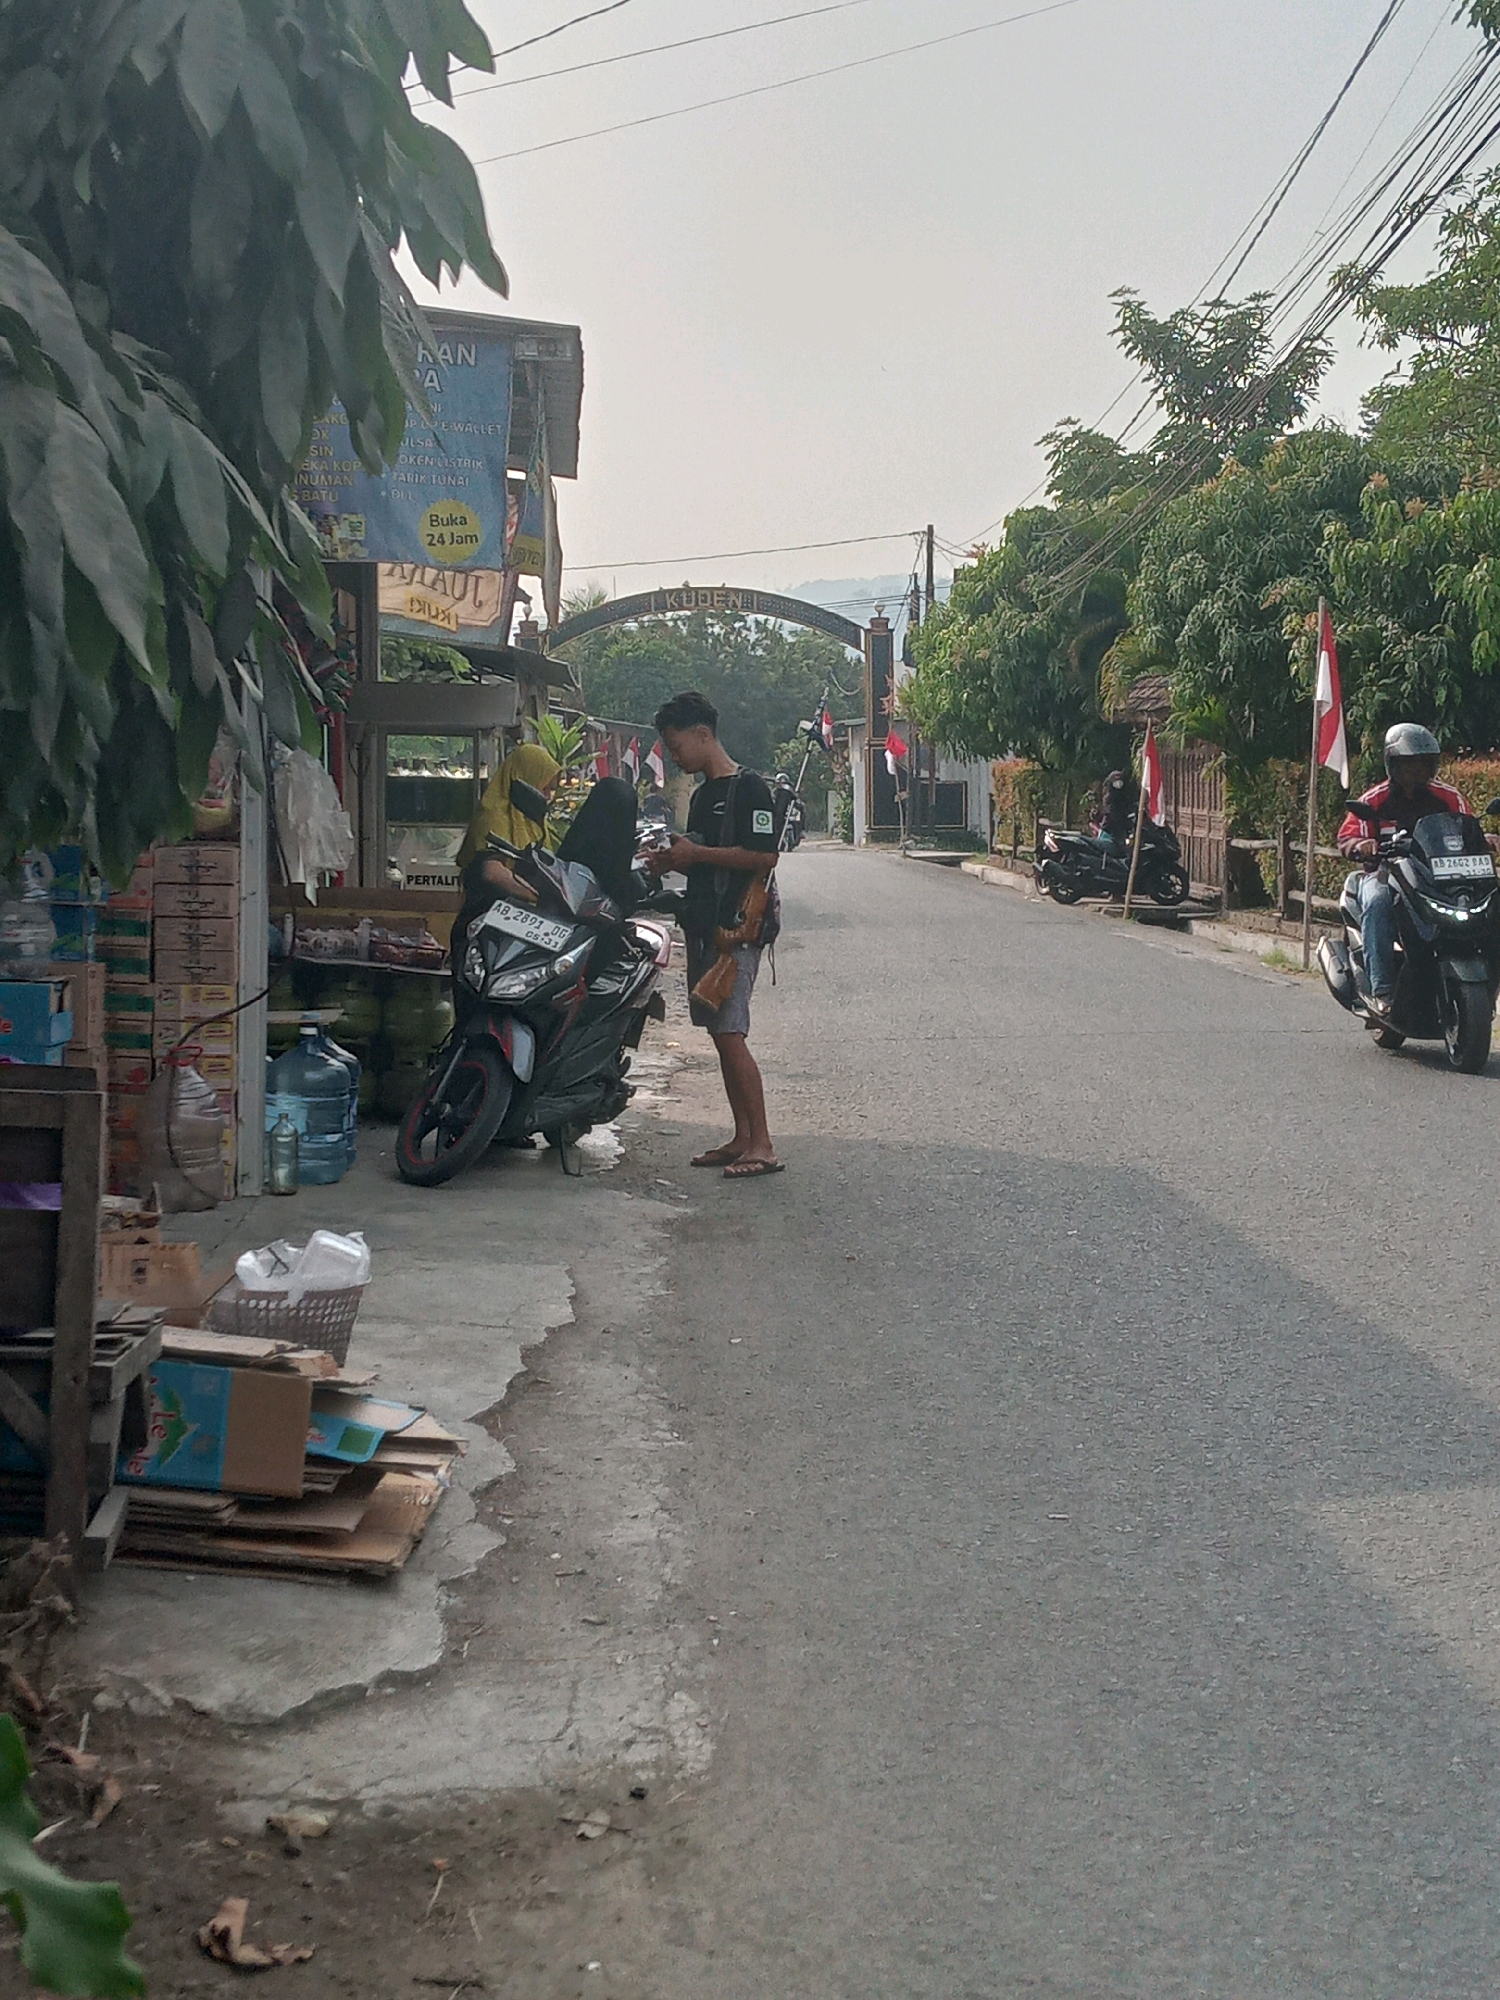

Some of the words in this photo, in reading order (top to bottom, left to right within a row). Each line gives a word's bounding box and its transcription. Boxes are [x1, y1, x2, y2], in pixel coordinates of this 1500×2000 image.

[441, 421, 503, 435] E-WALLET
[400, 437, 434, 449] ULSA
[309, 445, 334, 457] SIN
[300, 459, 329, 472] EKA
[399, 454, 434, 467] OKEN
[437, 456, 484, 469] LISTRIK
[294, 473, 354, 487] INUMAN
[392, 471, 426, 484] TARIK
[430, 473, 470, 487] TUNAI
[302, 490, 339, 502] BATU
[429, 513, 468, 528] Buka
[426, 532, 446, 547] 24
[449, 531, 479, 546] Jam
[665, 589, 743, 609] KUDEN
[492, 902, 511, 917] AB
[513, 911, 545, 930] 2891
